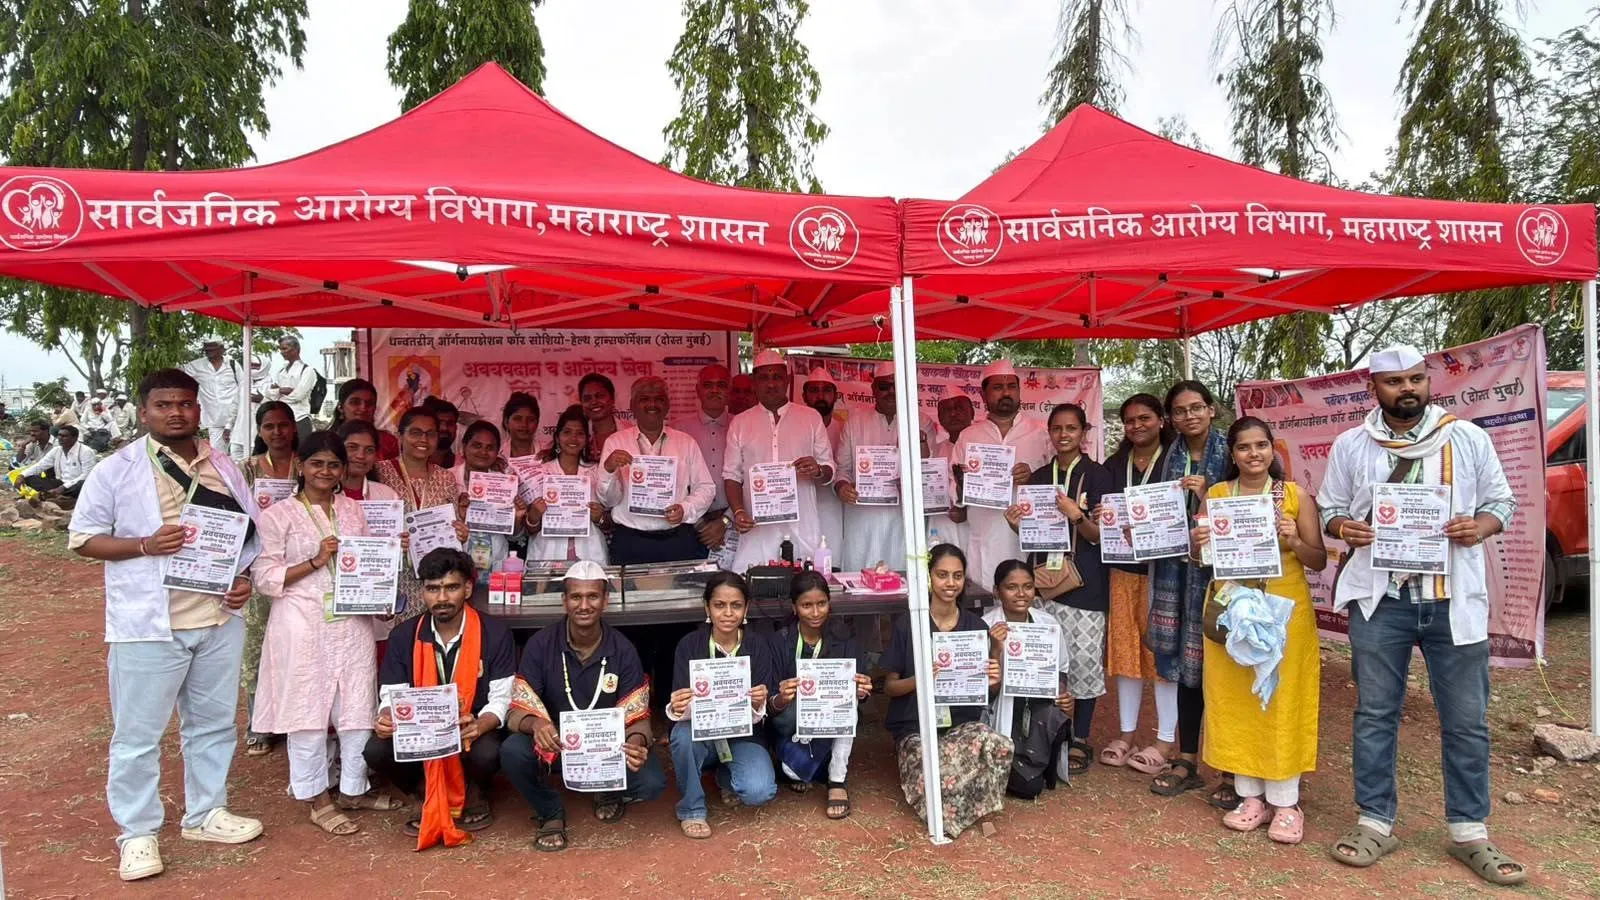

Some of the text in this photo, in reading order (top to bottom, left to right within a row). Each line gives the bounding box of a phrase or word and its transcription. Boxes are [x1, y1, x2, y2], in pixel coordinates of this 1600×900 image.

[86, 186, 769, 246] सार्वजनिक आरोग्य विभाग, महाराष्ट्र शासन
[1007, 202, 1503, 250] सार्वजनिक आरोग्य विभाग, महाराष्ट्र शासन
[507, 333, 525, 345] फॉर
[655, 334, 683, 347] (दोस्त
[1493, 377, 1524, 402] मुंबई)
[1330, 410, 1345, 424] फॉर
